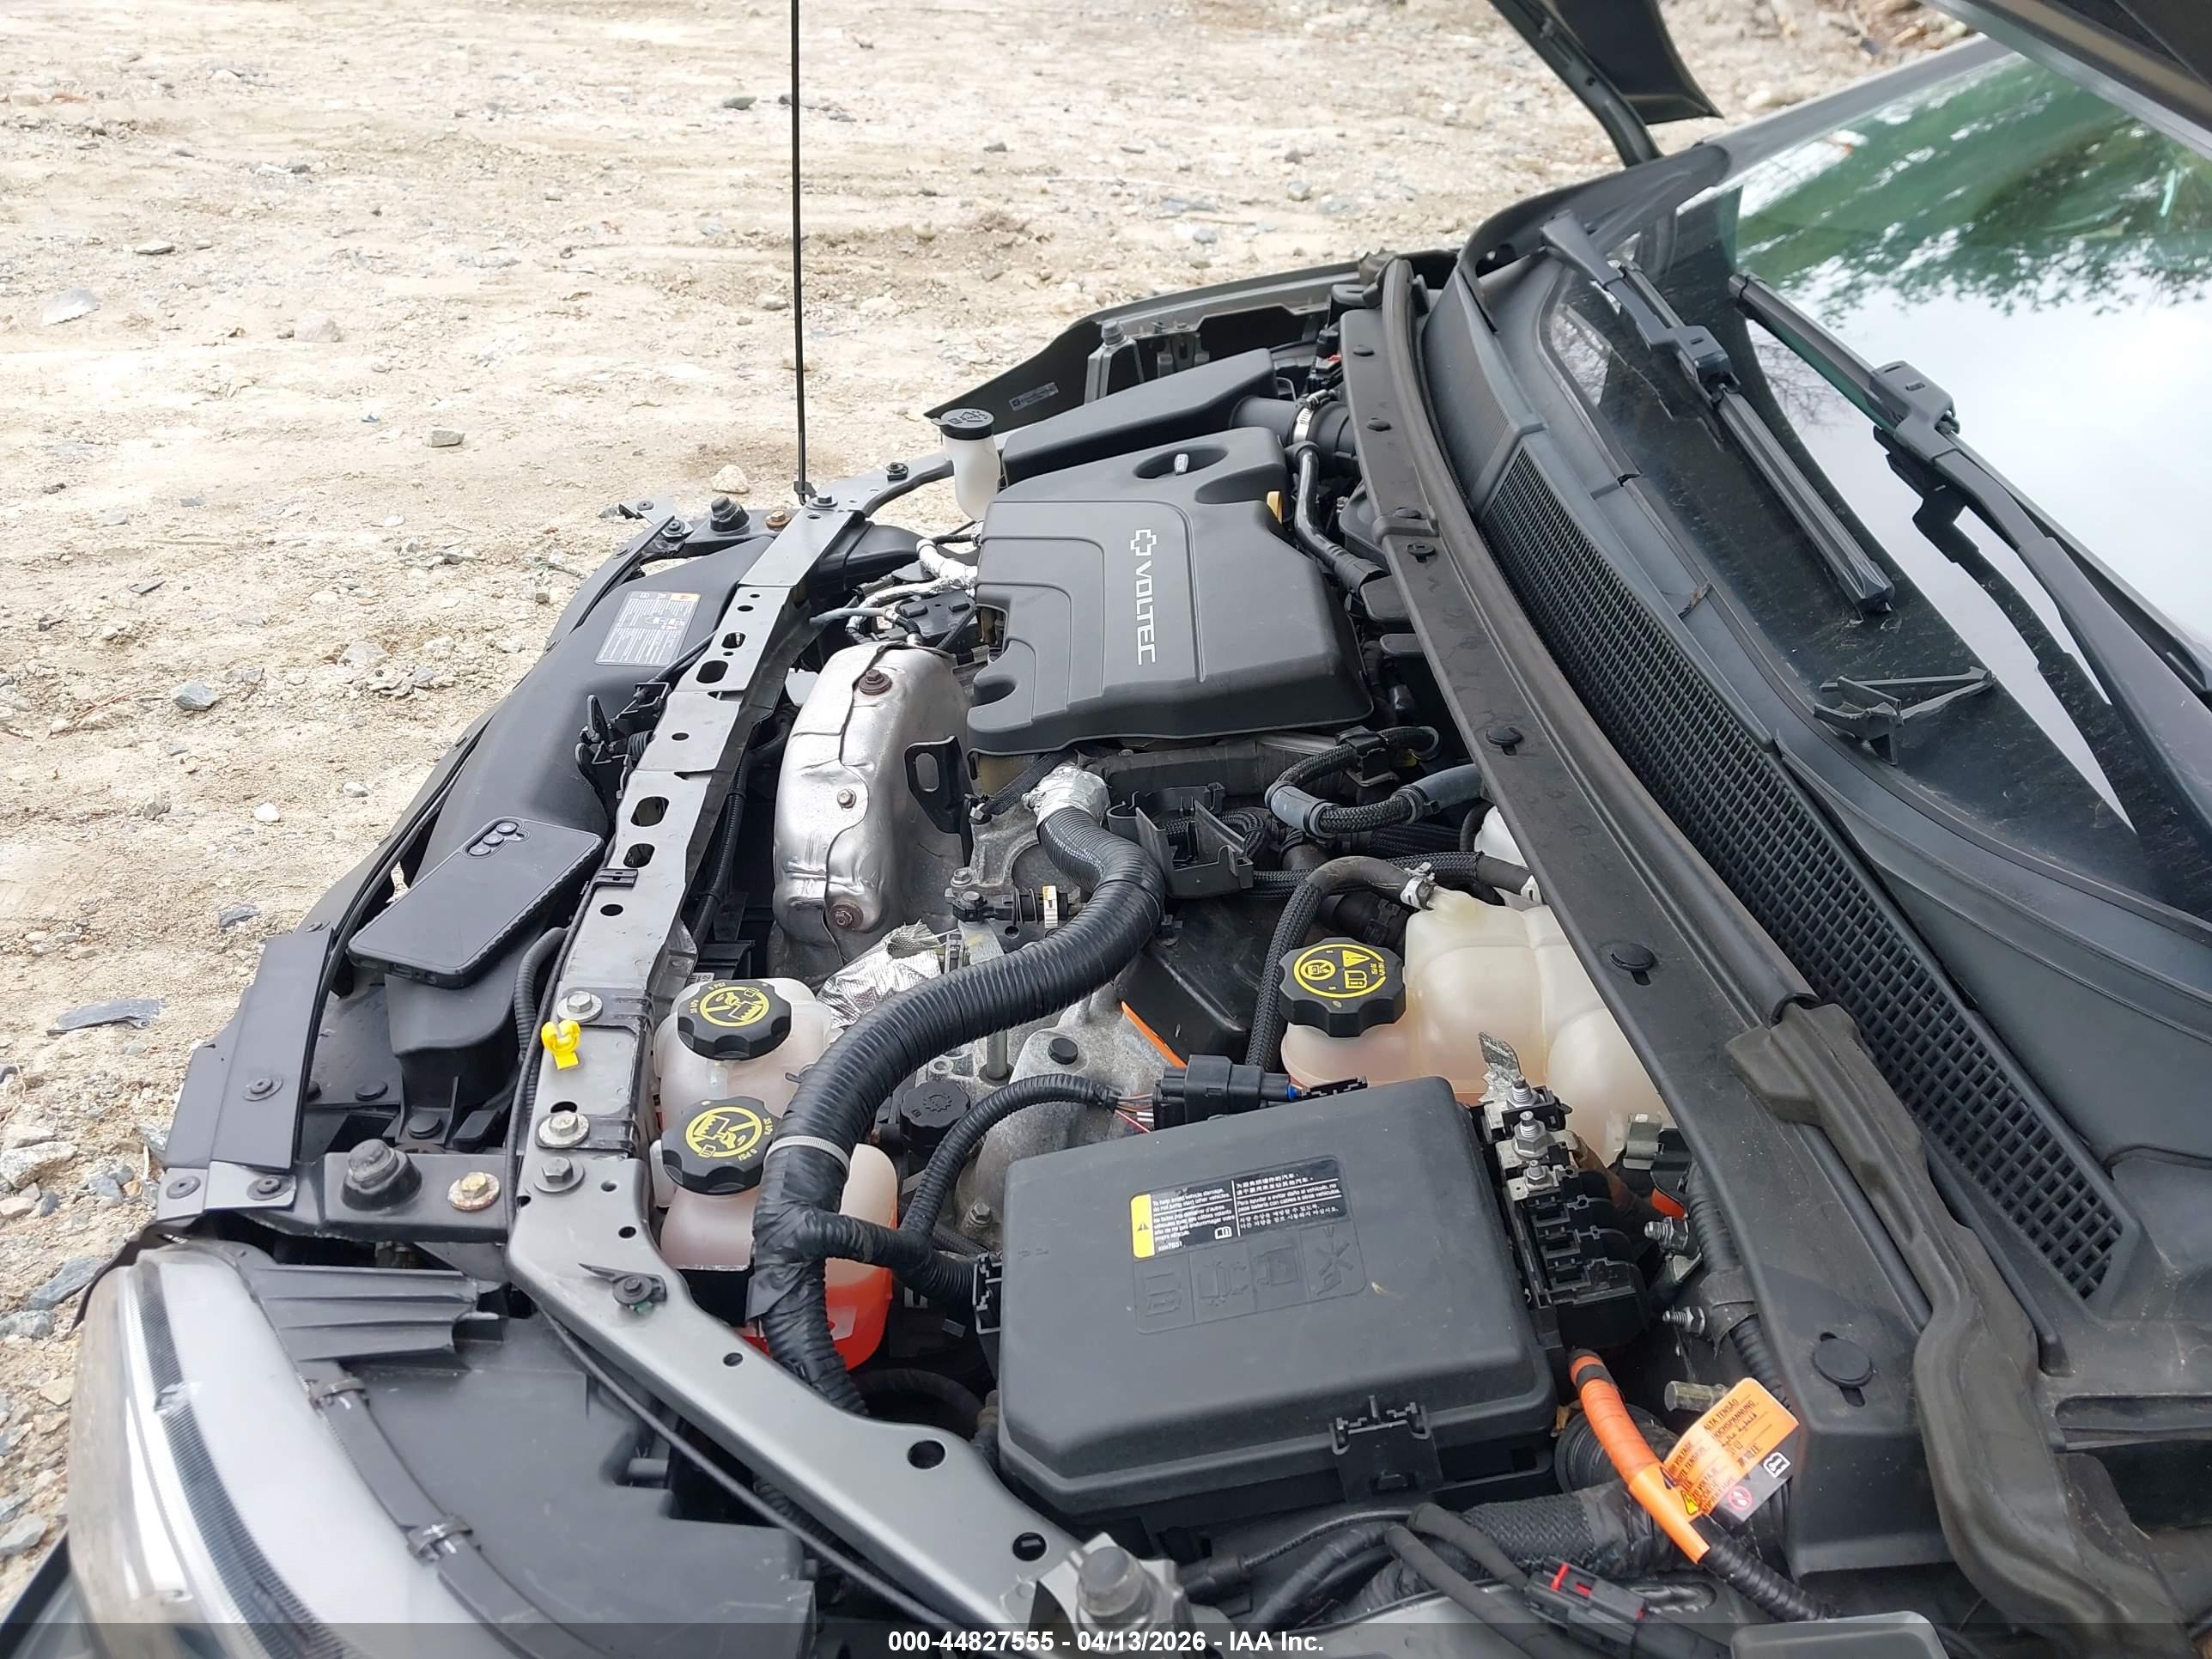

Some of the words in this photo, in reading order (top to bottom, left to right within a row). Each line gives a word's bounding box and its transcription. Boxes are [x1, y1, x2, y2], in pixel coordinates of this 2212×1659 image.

[1135, 560, 1157, 666] VOLTEC
[713, 981, 726, 989] PSI
[762, 1123, 775, 1135] kPa
[737, 1150, 751, 1162] PSI
[1714, 1396, 1739, 1419] TENSÃO
